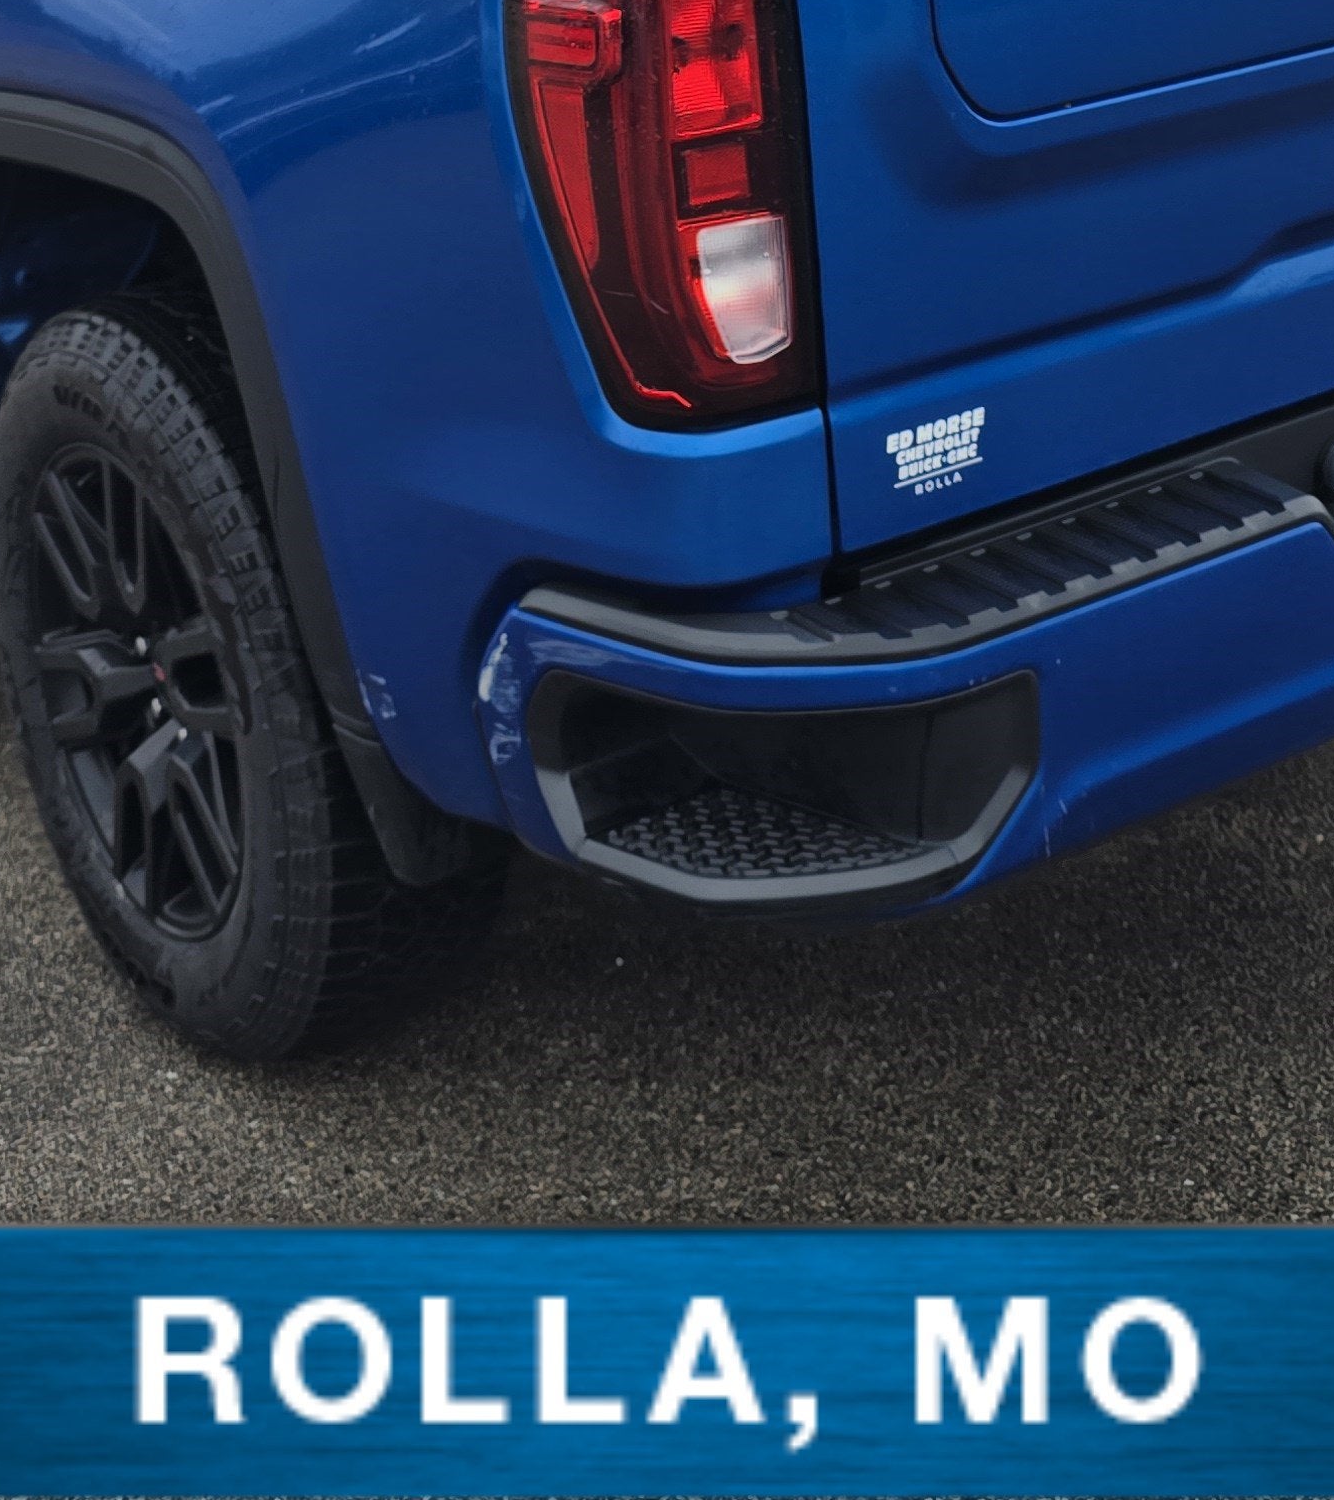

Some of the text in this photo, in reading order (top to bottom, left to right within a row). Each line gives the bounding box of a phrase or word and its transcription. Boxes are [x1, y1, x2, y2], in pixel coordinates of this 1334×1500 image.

[886, 406, 985, 454] ED MORSE
[895, 427, 980, 466] CHEVROLET
[914, 471, 963, 495] ROLLA
